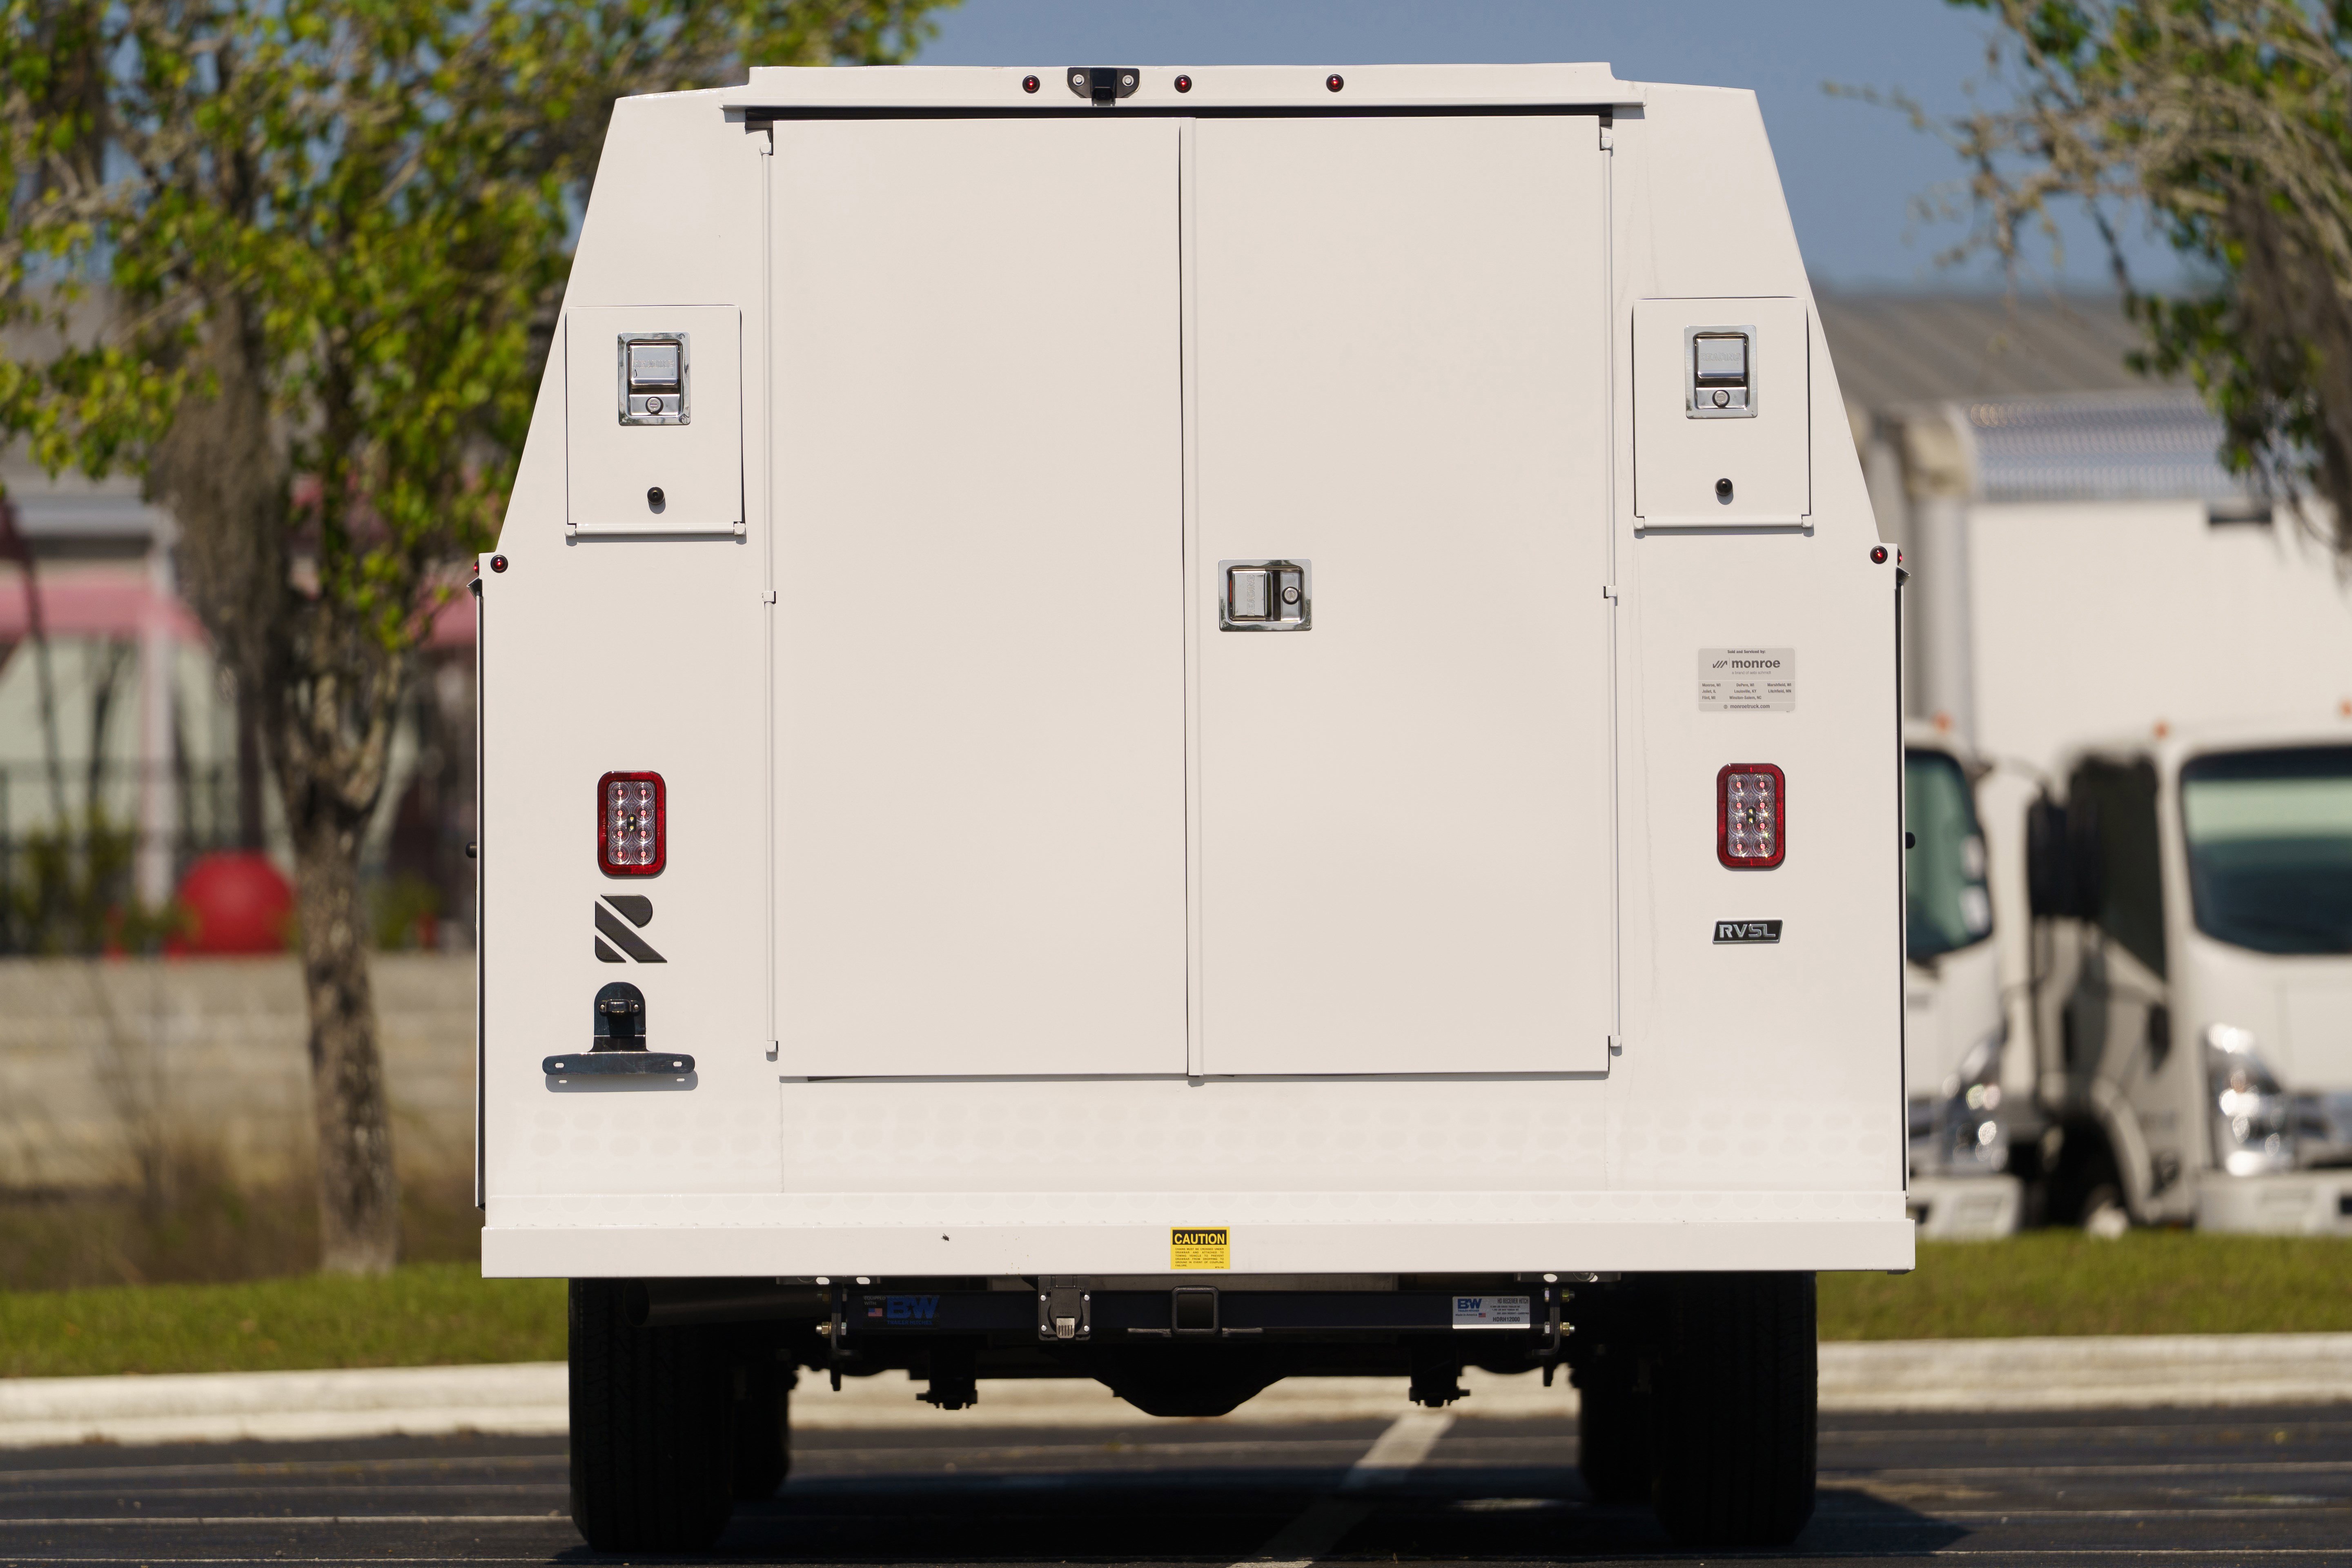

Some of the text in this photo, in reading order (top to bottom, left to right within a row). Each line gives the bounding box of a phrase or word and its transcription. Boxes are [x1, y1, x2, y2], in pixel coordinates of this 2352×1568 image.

[1699, 353, 1741, 361] READING
[633, 360, 675, 369] READING
[1732, 660, 1780, 668] monroe
[1719, 924, 1775, 938] RVSL
[1174, 1234, 1225, 1244] CAUTION
